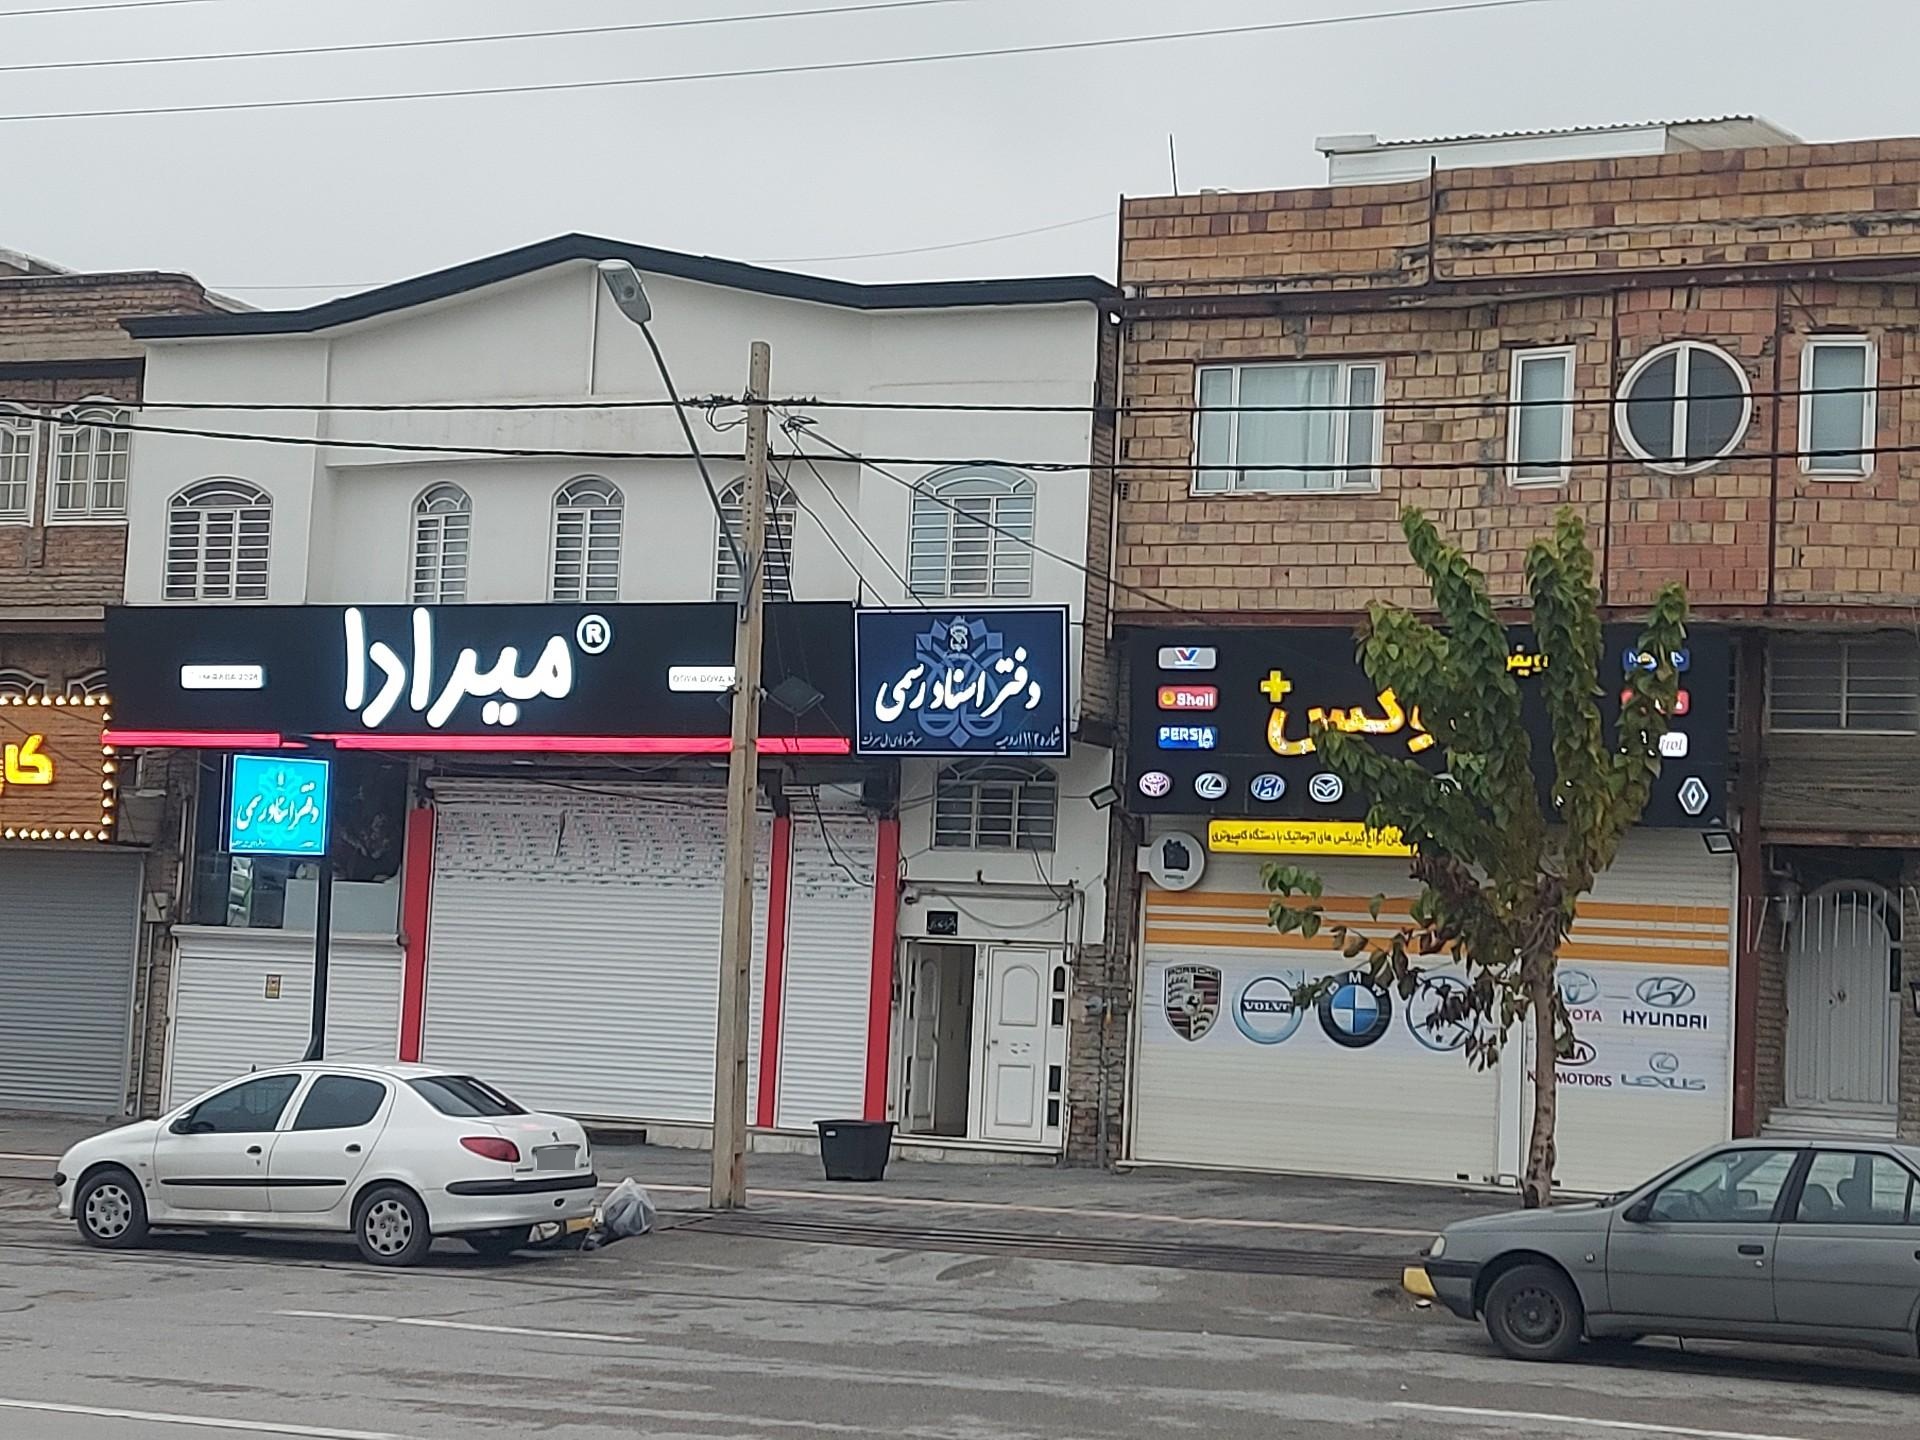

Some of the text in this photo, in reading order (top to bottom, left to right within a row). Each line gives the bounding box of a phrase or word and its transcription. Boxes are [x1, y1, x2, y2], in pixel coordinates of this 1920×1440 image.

[344, 607, 572, 728] میرادا
[875, 646, 1041, 722] دفتر اسناد رسمی
[1177, 693, 1214, 706] Shell
[1160, 727, 1213, 741] PERSIA
[1211, 829, 1248, 847] کامپیوتری
[1249, 827, 1276, 842] دستگاه
[1283, 831, 1316, 845] اتوماتیک
[1317, 831, 1332, 845] های
[1333, 831, 1365, 846] گیربکس
[1622, 1010, 1708, 1031] HYUNDAI
[1554, 1070, 1613, 1088] MOTORS
[1621, 1073, 1706, 1092] LEXUS
